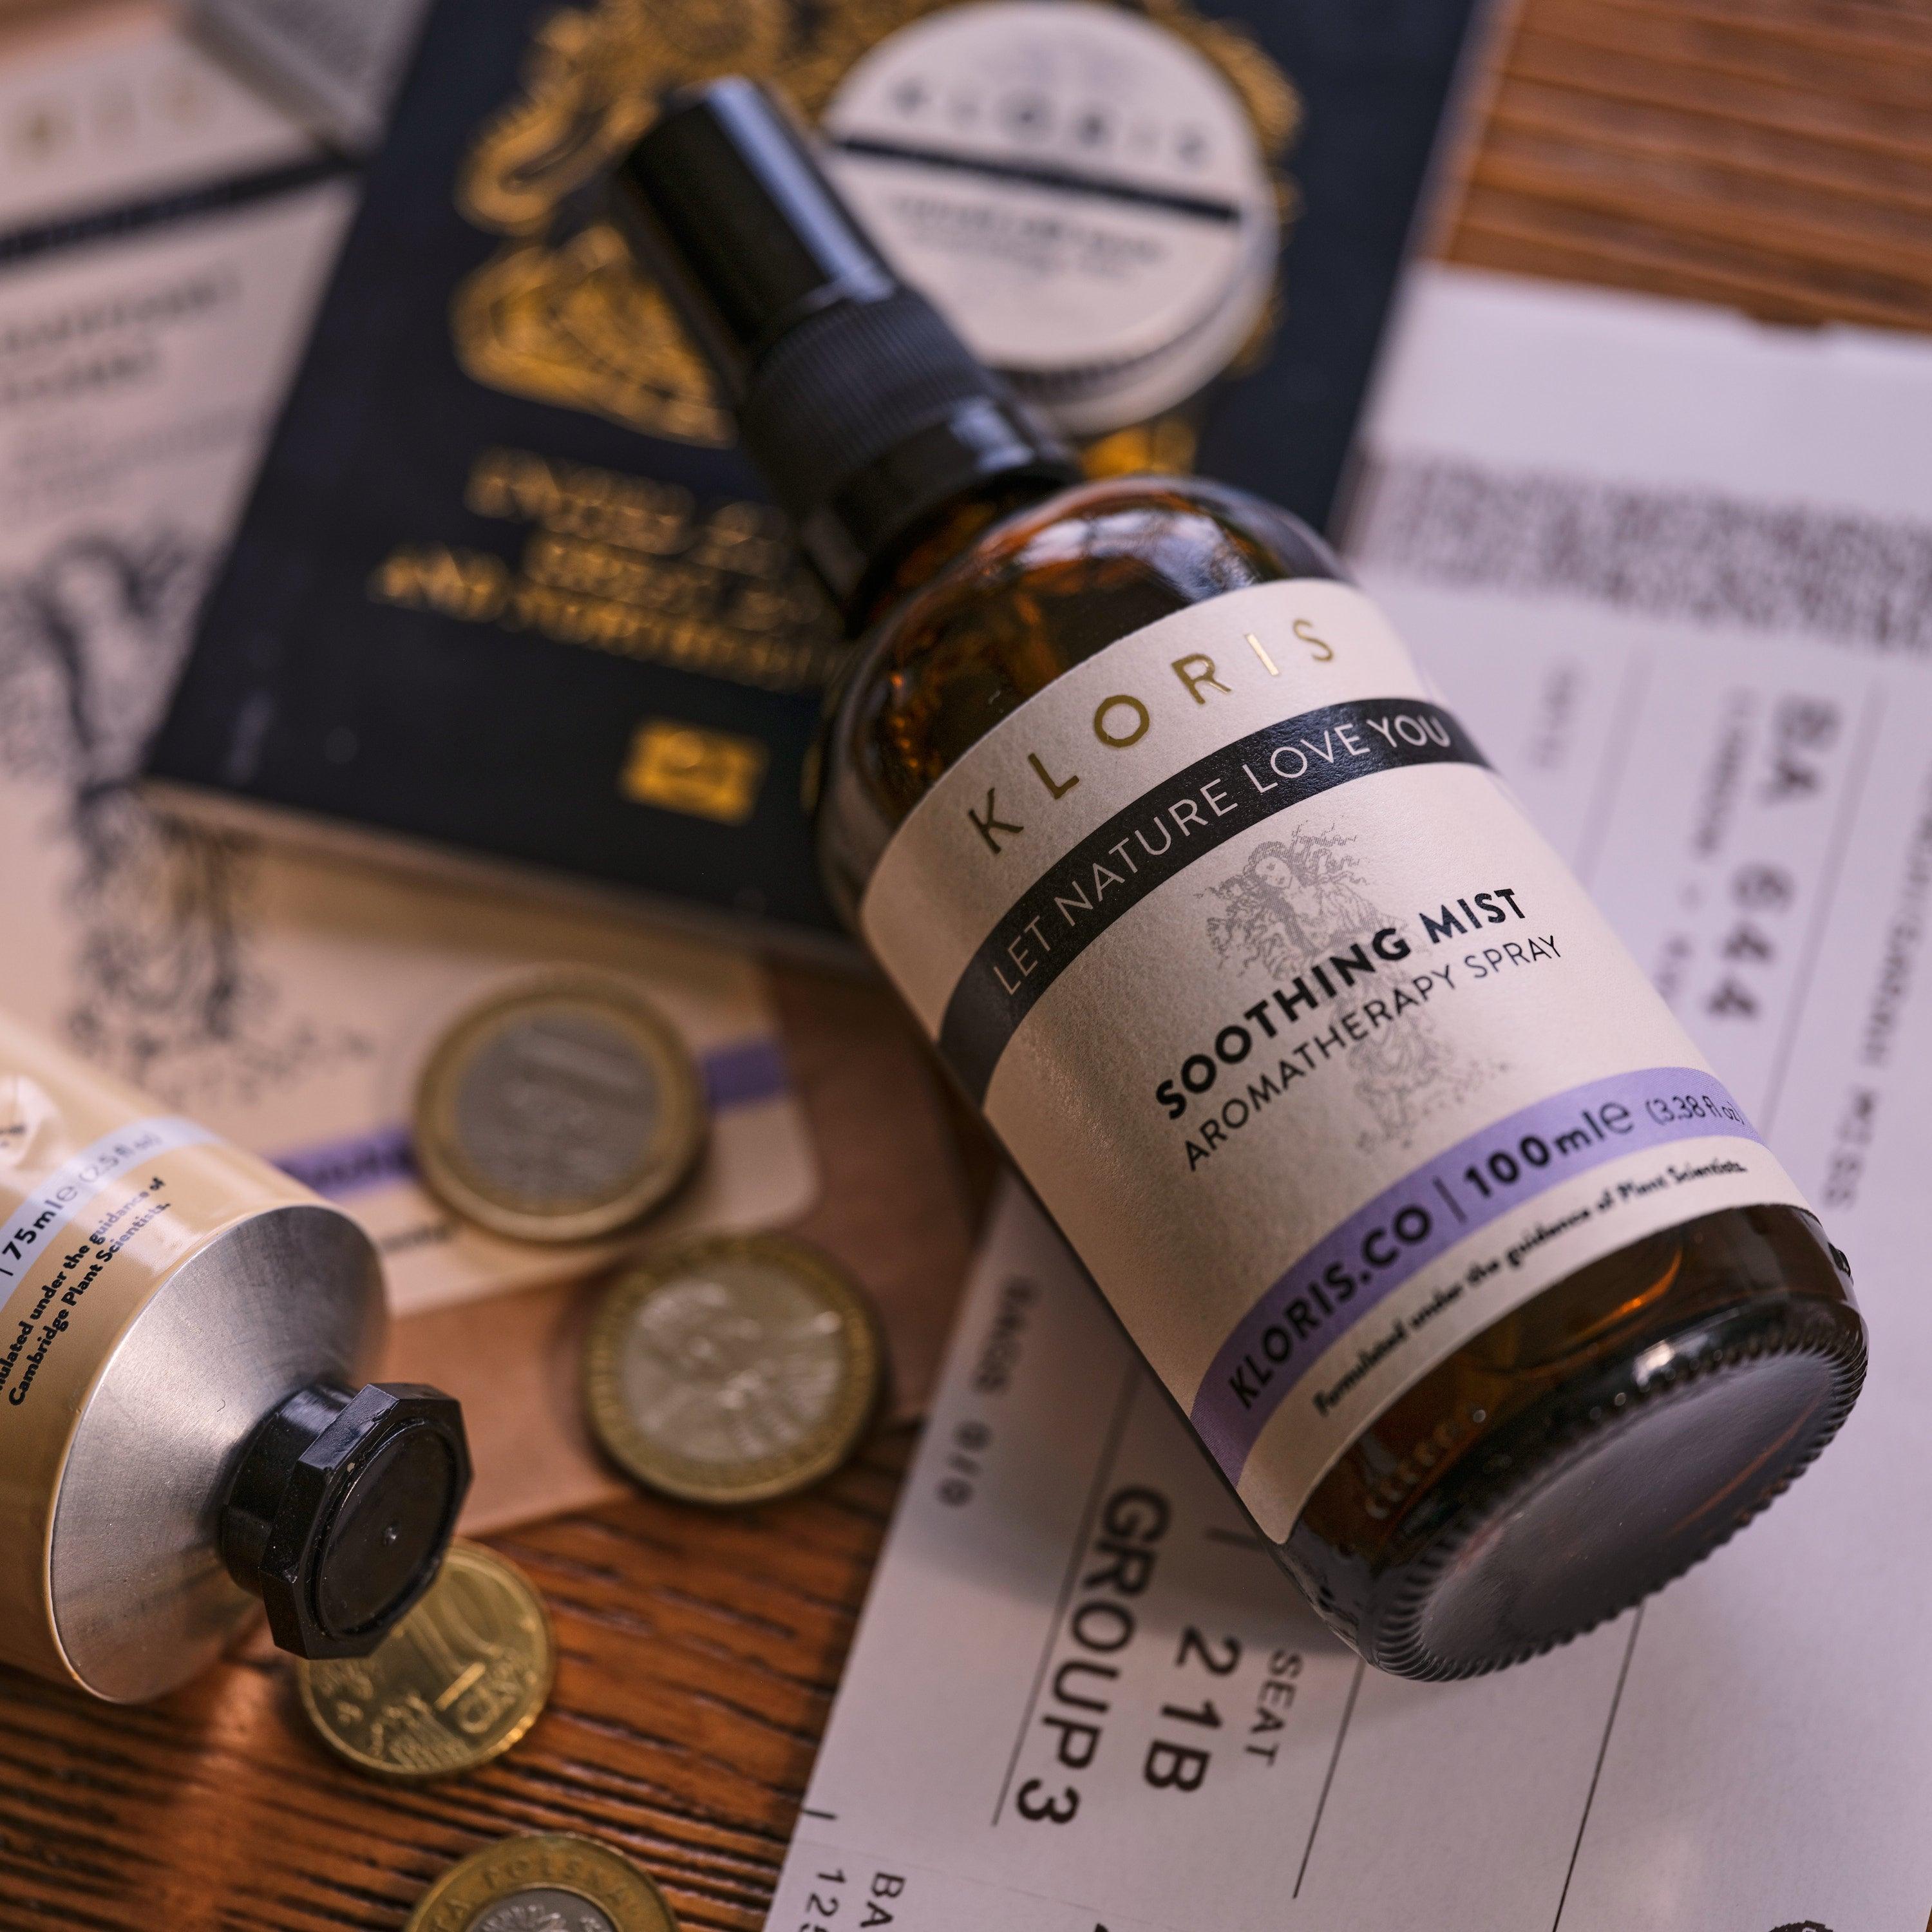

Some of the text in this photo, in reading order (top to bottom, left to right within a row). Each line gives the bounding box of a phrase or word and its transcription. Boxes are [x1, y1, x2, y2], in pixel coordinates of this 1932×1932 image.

[969, 619, 1335, 854] KLORIS
[993, 715, 1451, 996] LET NATURE LOVE YOU
[1155, 888, 1526, 1120] SOOTHING MIST
[1181, 965, 1456, 1171] AROMATHERAPY
[1464, 935, 1562, 978] SPRAY
[9, 1202, 171, 1406] Cambridge Plant Scientists.
[30, 1271, 66, 1320] under
[63, 1245, 90, 1269] the
[89, 1191, 149, 1245] guidance
[149, 1176, 166, 1191] of
[1227, 1207, 1432, 1410] KLORIS.CO
[1312, 1320, 1406, 1415] Formulated
[1410, 1289, 1463, 1331] under
[1506, 1211, 1589, 1269] guidance
[1597, 1189, 1615, 1211] of
[1617, 1177, 1667, 1203] Plant
[1143, 1625, 1242, 1793] 21B
[1244, 1649, 1303, 1766] SEAT
[860, 1871, 905, 1928] BA
